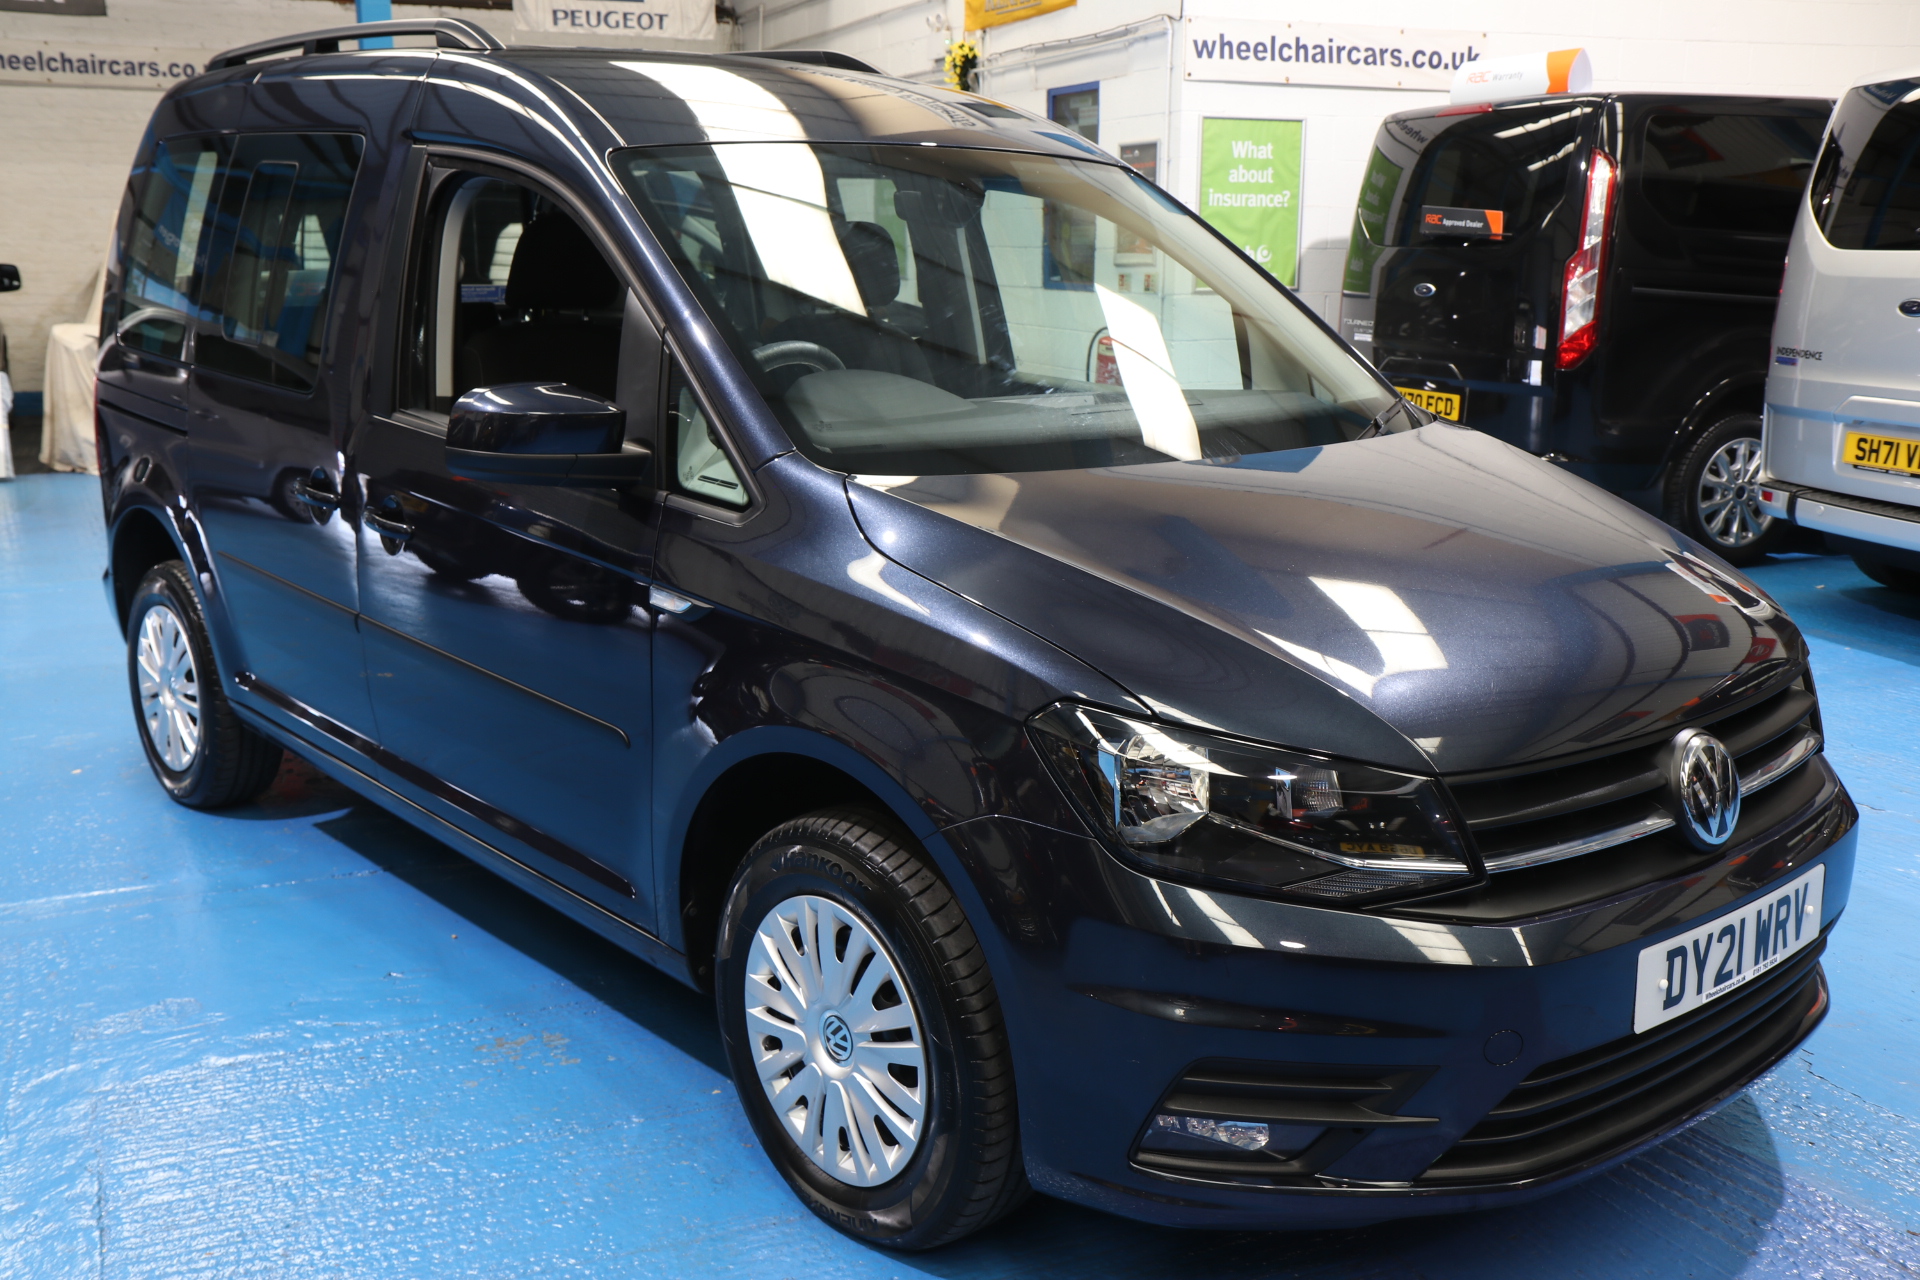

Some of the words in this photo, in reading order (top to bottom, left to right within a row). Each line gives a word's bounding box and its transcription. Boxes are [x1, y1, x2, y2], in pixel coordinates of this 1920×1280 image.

[553, 9, 669, 30] PEUGEOT
[1193, 33, 1480, 71] wheelchaircars.co.uk
[1492, 71, 1524, 82] Warranty
[1231, 140, 1274, 160] What
[1228, 164, 1274, 184] about
[1208, 188, 1291, 207] insurance?
[1442, 218, 1466, 227] Approved
[1465, 219, 1484, 229] Dealer
[1776, 346, 1823, 361] INDEPENDENCE
[1426, 395, 1453, 416] FCD
[1855, 437, 1900, 466] SH71
[1662, 917, 1746, 1011] DY21
[1754, 882, 1809, 967] WRV
